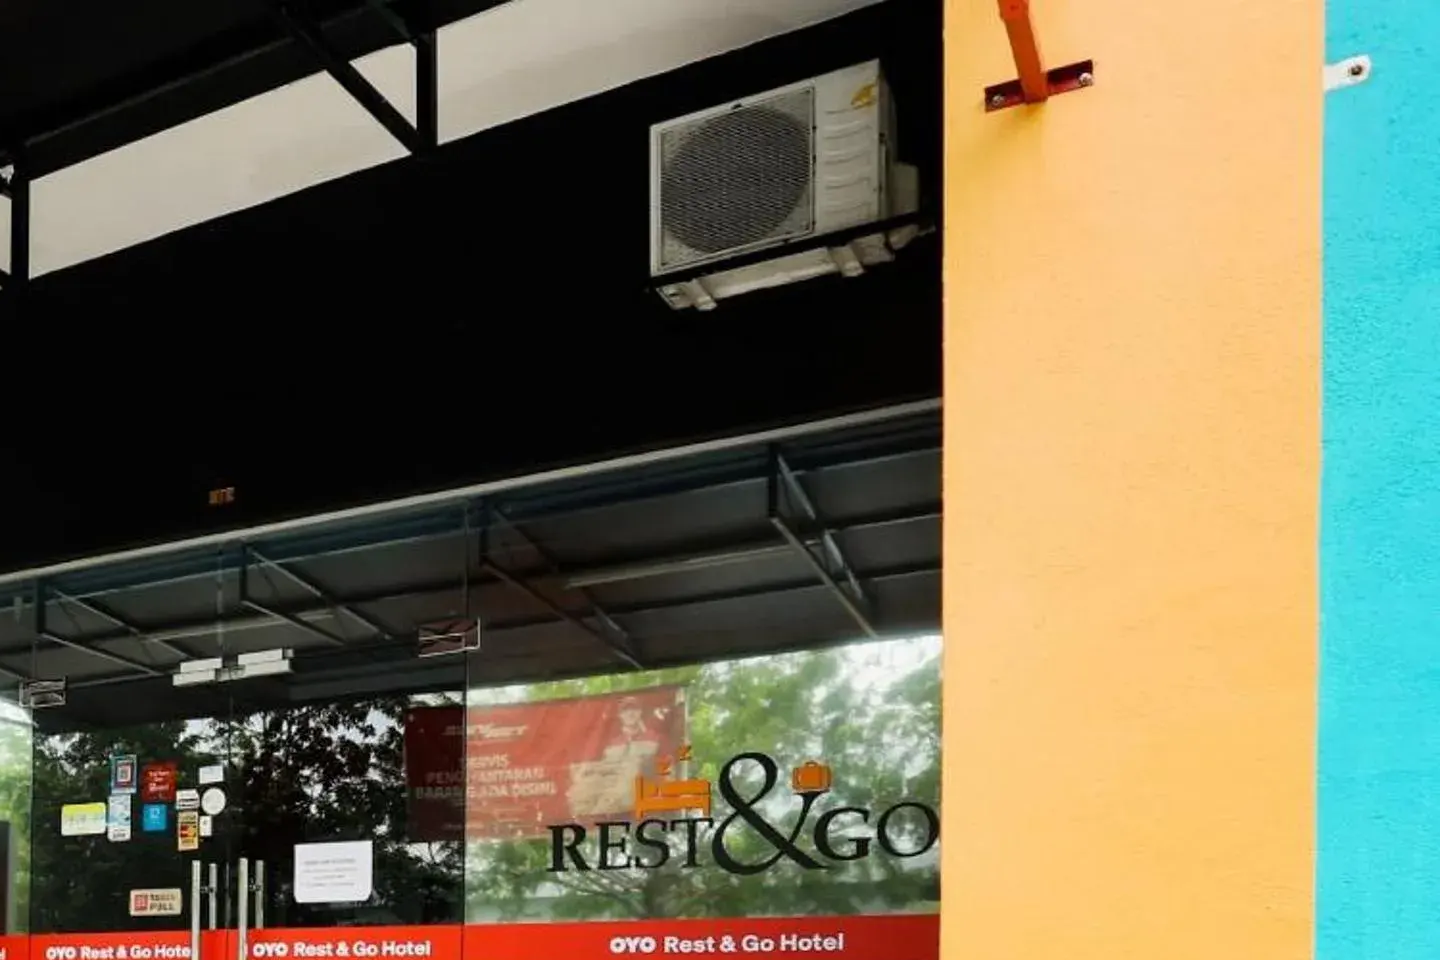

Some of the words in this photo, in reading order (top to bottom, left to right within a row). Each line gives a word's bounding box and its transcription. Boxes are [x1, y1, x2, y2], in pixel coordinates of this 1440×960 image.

[46, 946, 76, 960] OYO
[80, 945, 113, 960] Rest
[116, 945, 128, 960] &
[130, 945, 151, 960] Go
[155, 943, 192, 959] Hote
[253, 942, 288, 957] OYO
[293, 941, 331, 957] Rest
[334, 941, 349, 957] &
[353, 941, 378, 956] Go
[382, 939, 431, 956] Hotel
[610, 937, 656, 954] OYO
[664, 935, 714, 954] Rest
[719, 935, 736, 953] &
[743, 934, 775, 953] Go
[780, 932, 844, 952] Hotel
